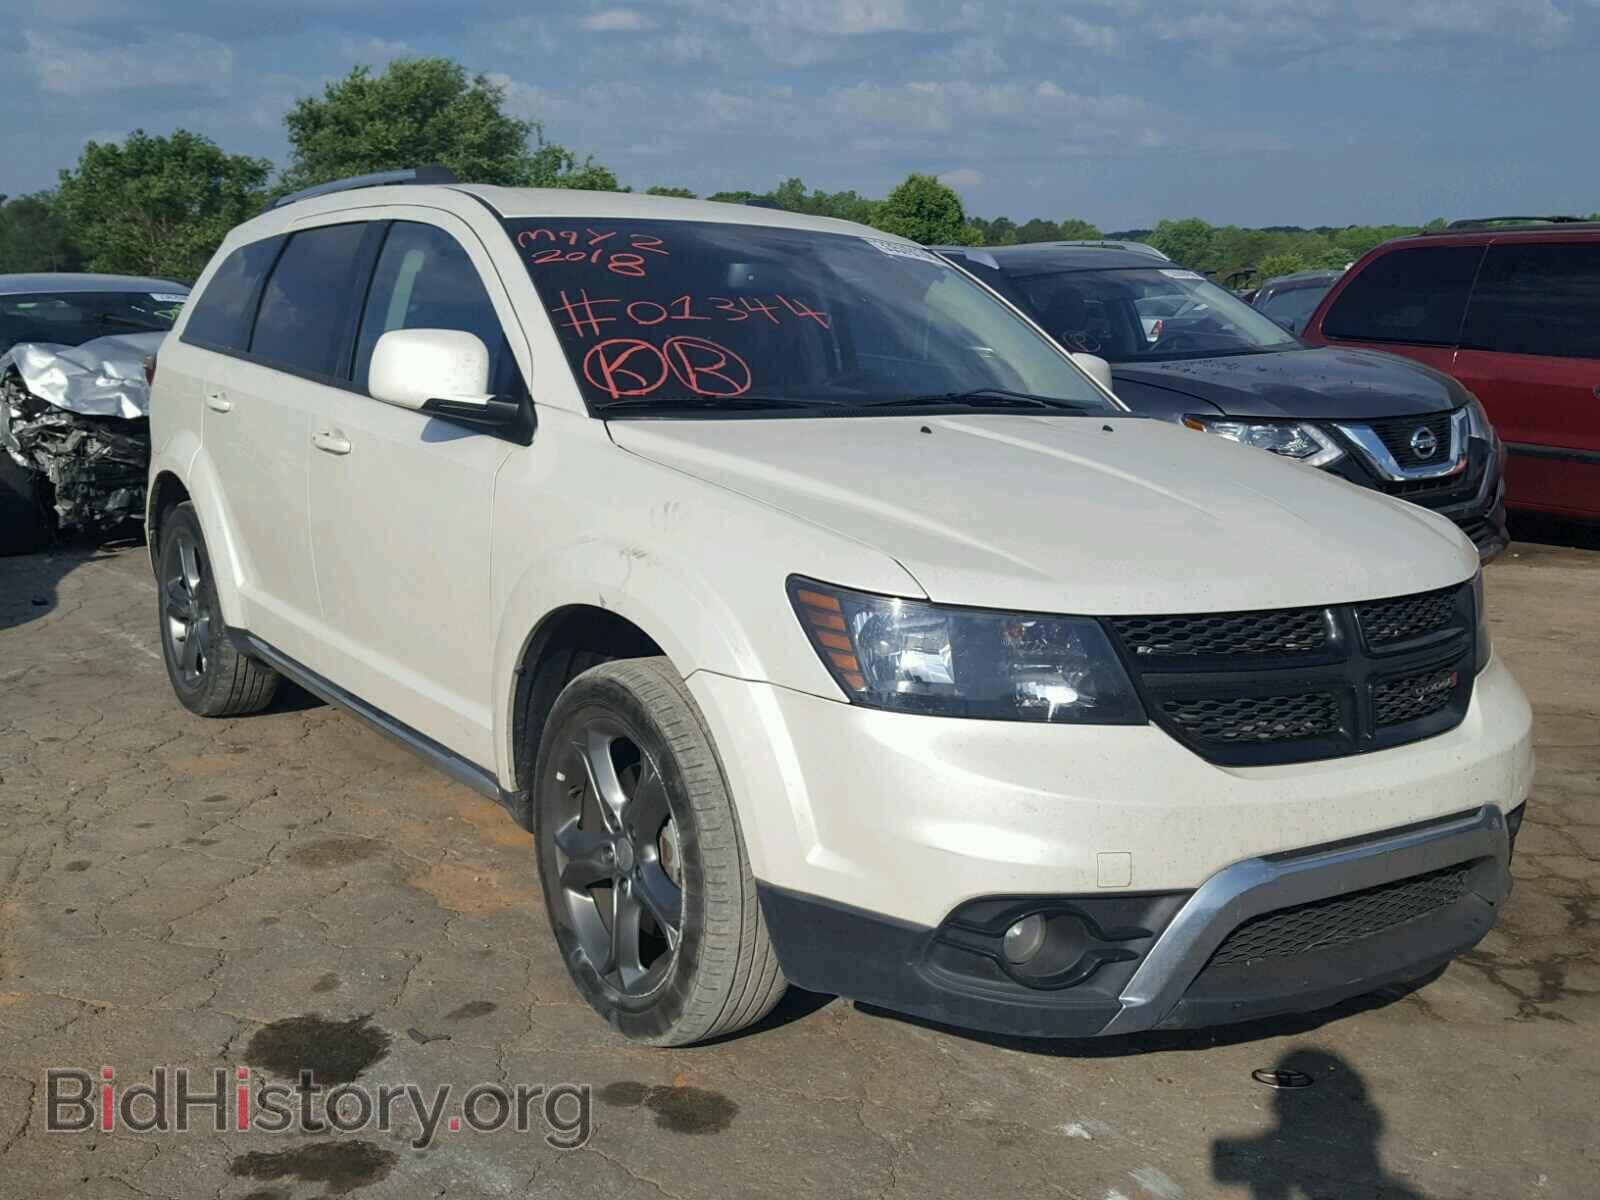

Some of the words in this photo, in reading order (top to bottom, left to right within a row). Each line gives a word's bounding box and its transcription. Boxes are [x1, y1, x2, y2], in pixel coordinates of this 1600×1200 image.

[629, 234, 670, 255] 2
[531, 249, 646, 277] 2018
[551, 288, 831, 338] #01344
